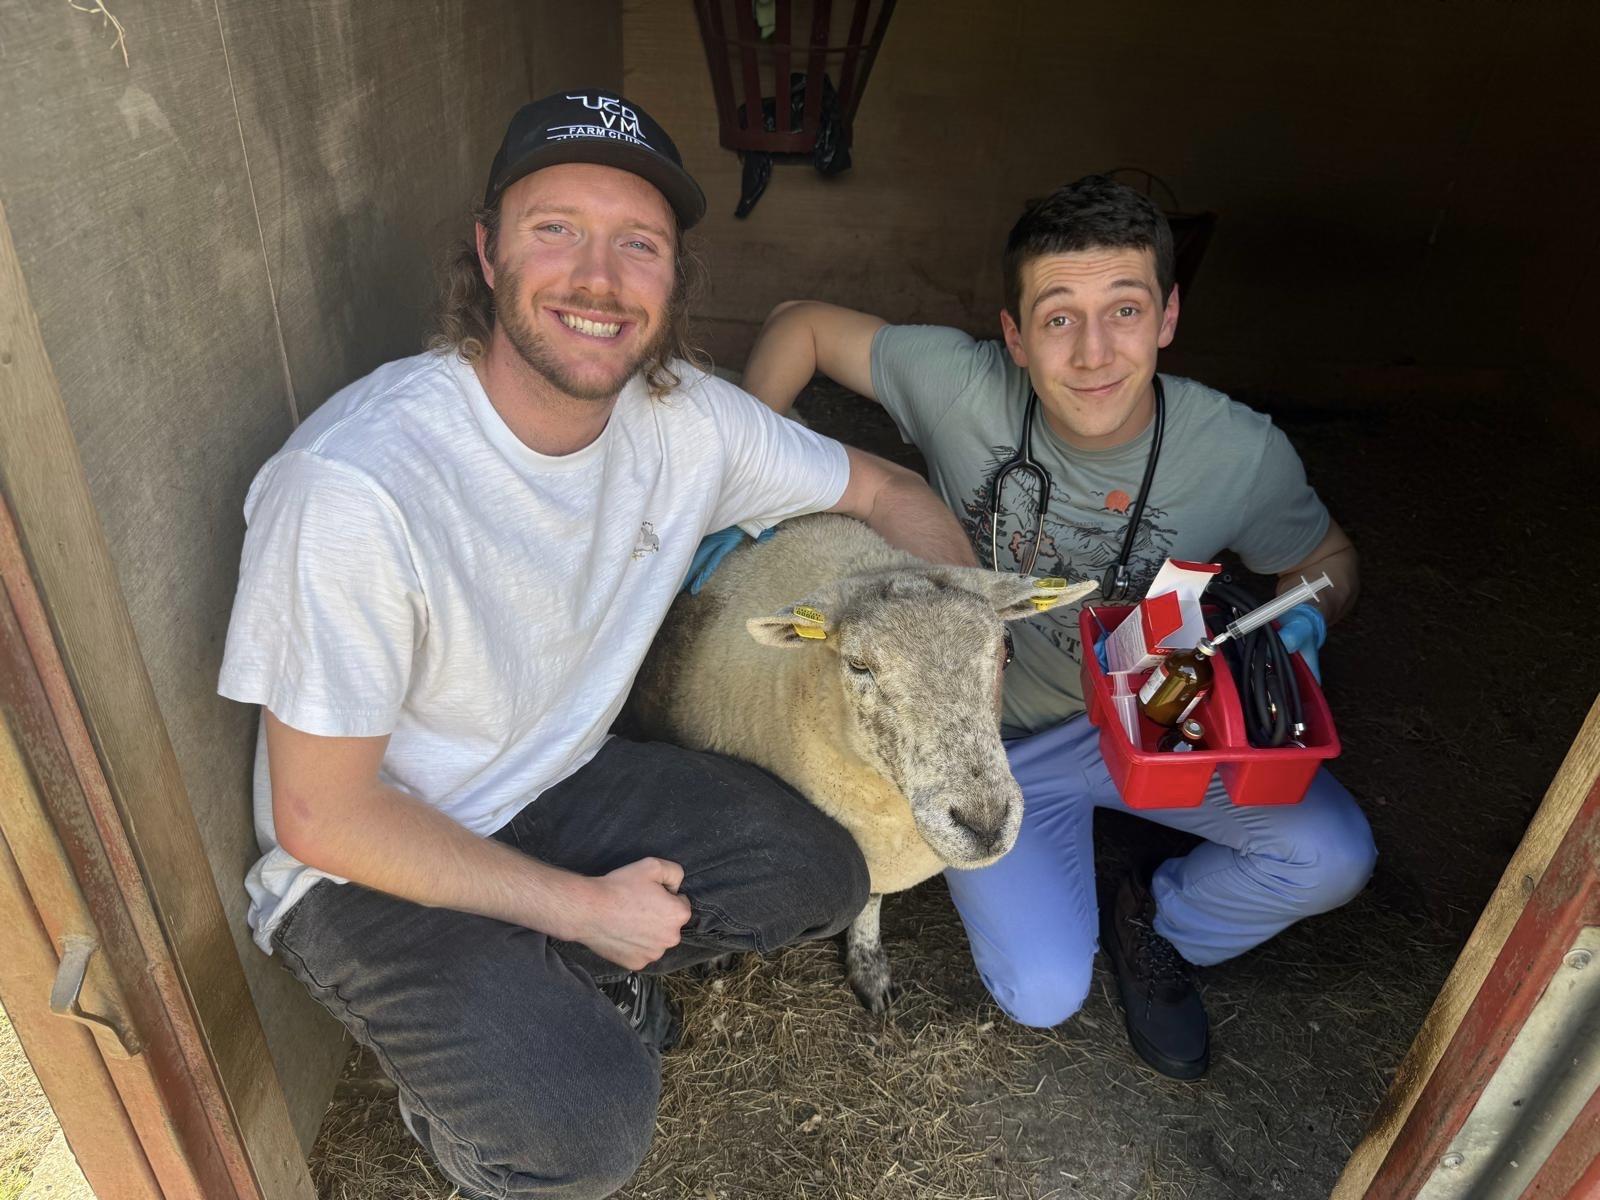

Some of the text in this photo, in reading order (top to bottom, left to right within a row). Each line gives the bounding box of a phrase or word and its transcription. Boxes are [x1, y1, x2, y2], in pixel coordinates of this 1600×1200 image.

[566, 95, 638, 121] UCD
[569, 127, 605, 136] FARM
[600, 111, 637, 137] VM
